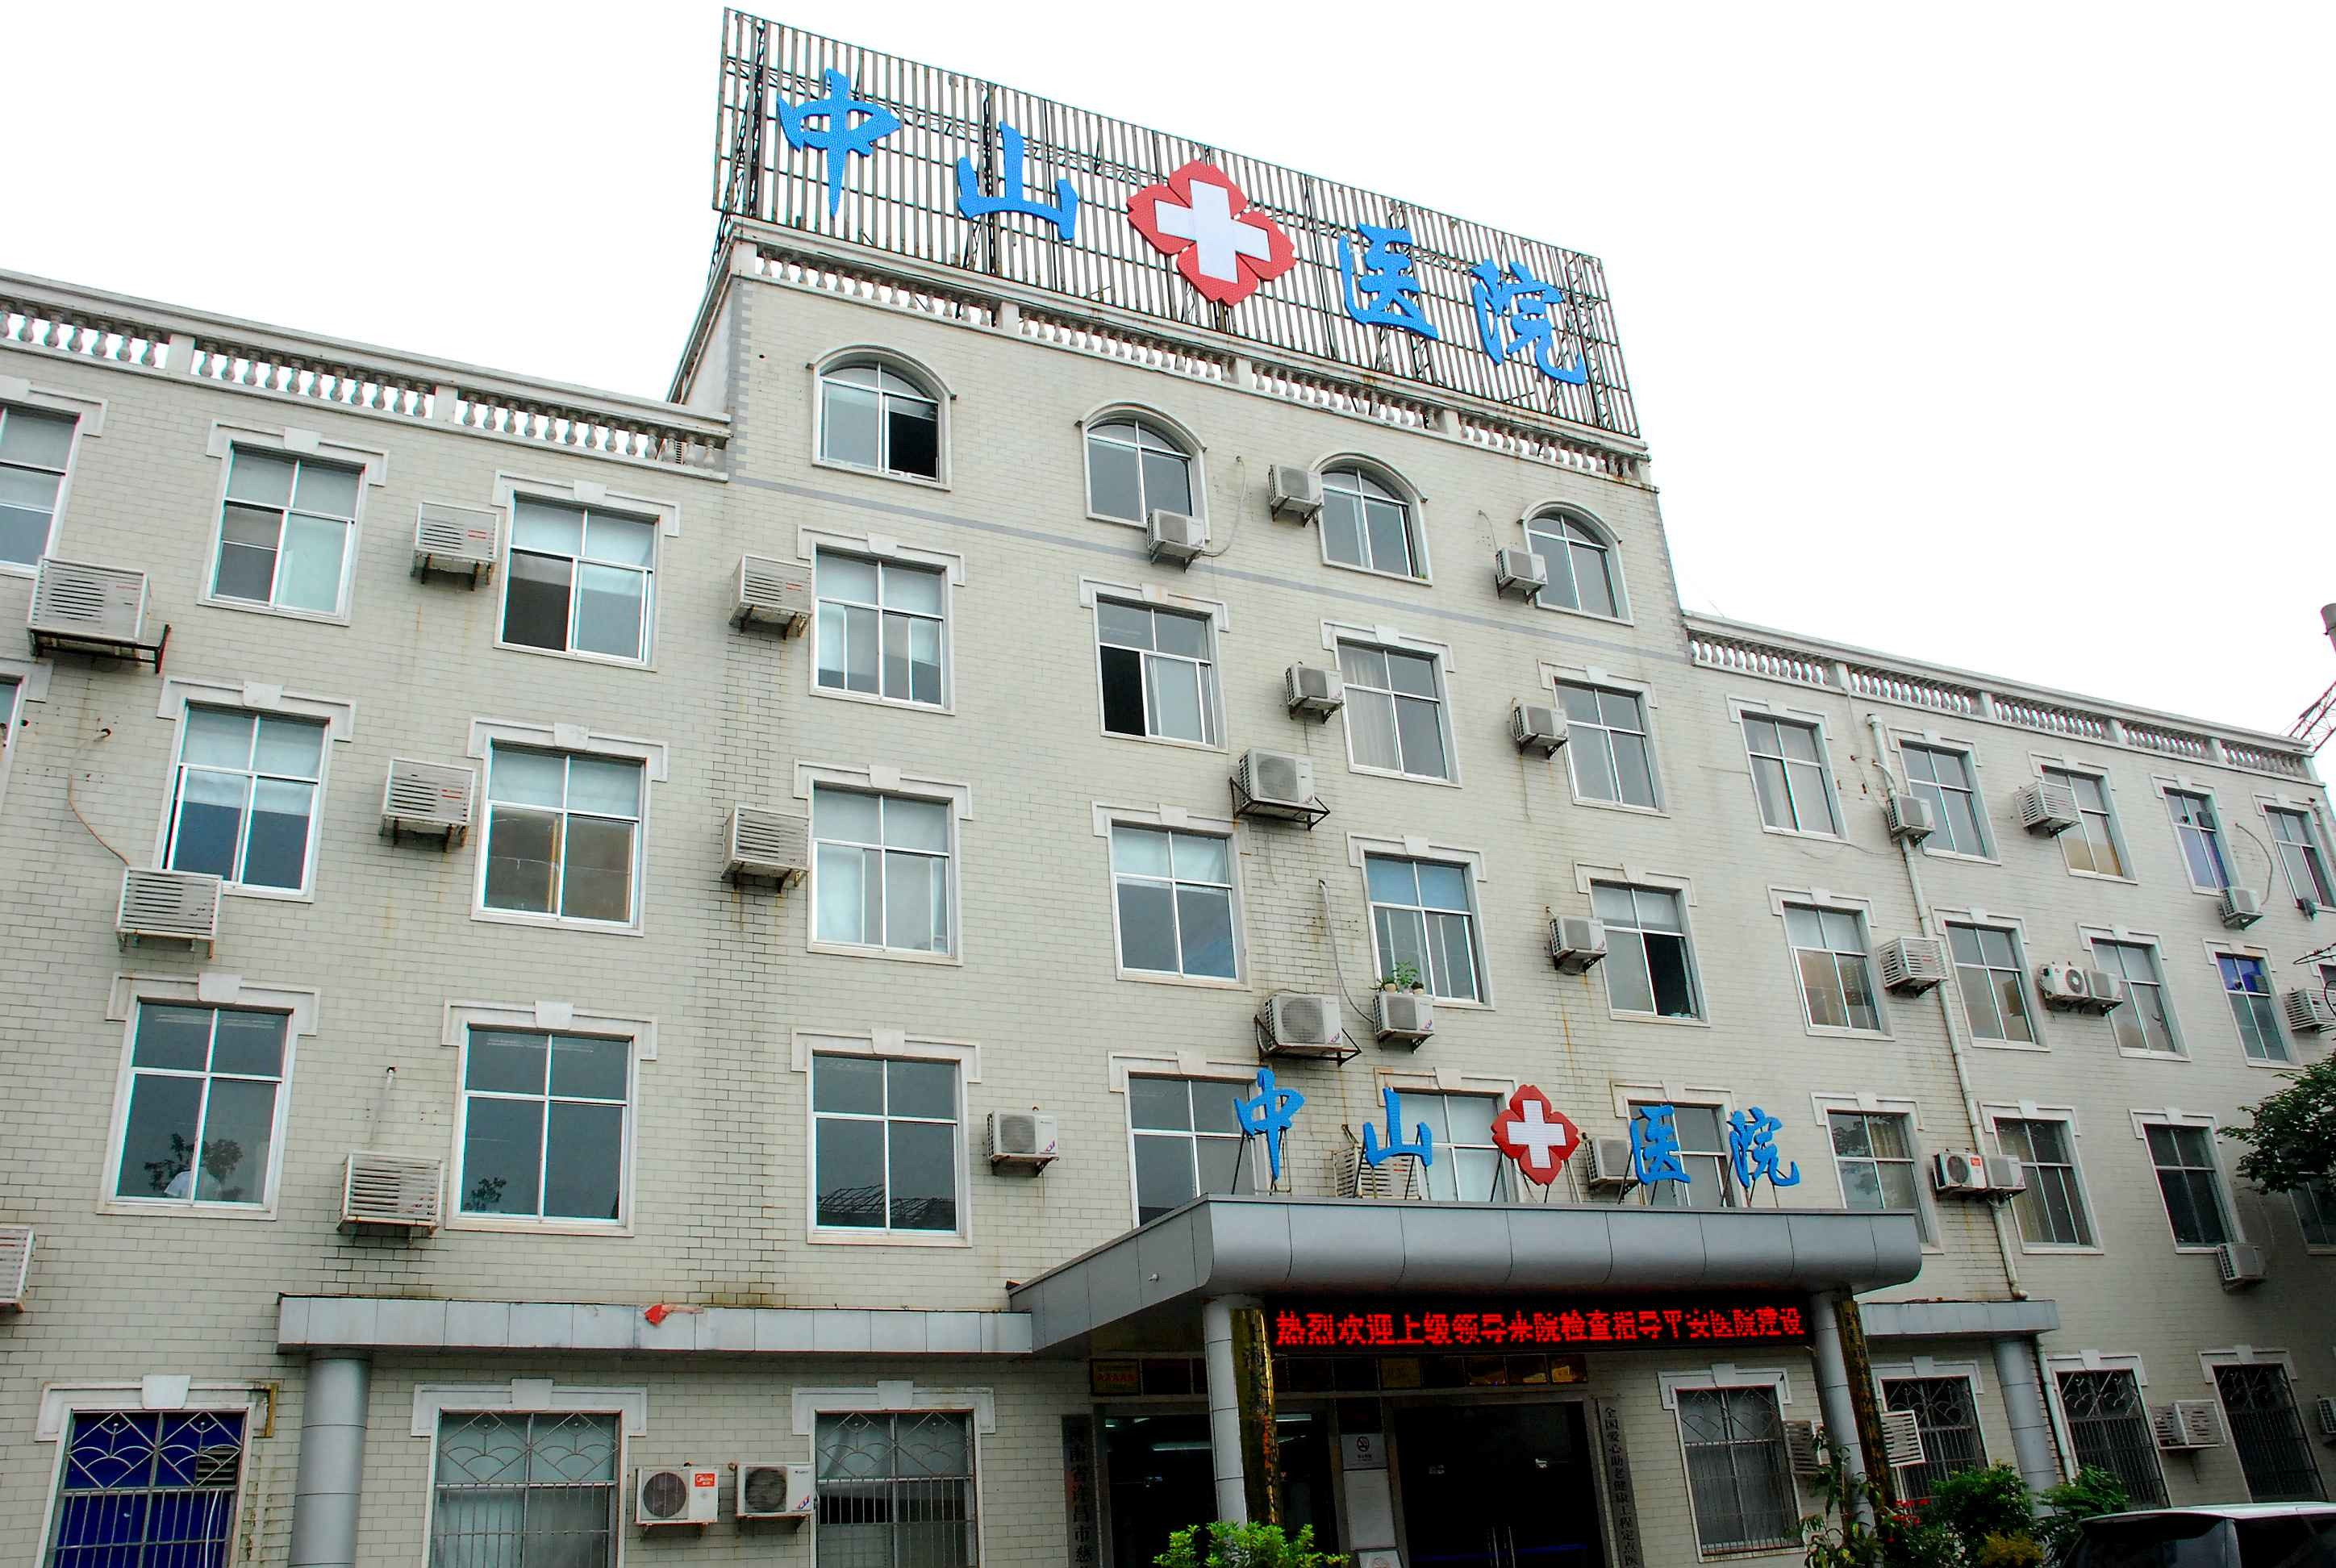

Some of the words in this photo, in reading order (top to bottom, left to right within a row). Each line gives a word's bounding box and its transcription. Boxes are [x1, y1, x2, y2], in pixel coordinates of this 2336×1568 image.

[775, 67, 1079, 240] 中山
[1338, 220, 1587, 385] 医院
[1233, 1067, 1433, 1180] 中山
[1630, 1105, 1800, 1187] 医院
[1275, 1306, 1805, 1345] 热烈欢迎上级领导来院检查指导平安医院建设
